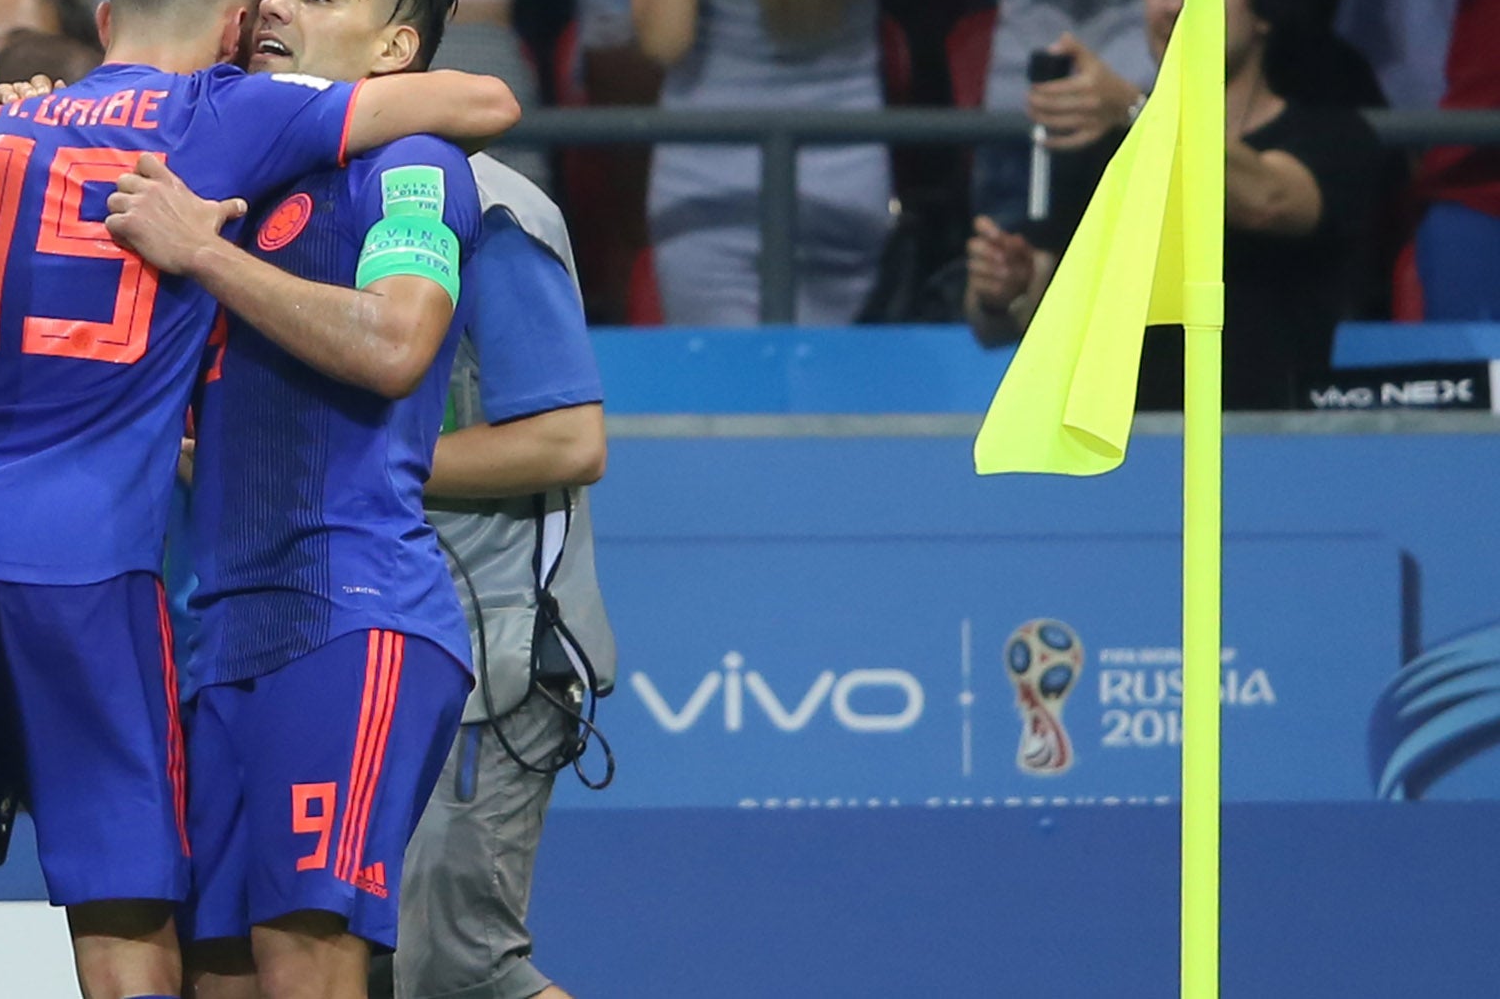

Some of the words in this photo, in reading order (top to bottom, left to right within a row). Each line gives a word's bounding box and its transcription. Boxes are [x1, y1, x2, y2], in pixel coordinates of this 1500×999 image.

[386, 183, 438, 193] LIVING
[363, 238, 449, 259] OOTBALL
[372, 228, 449, 249] IVING
[414, 253, 450, 277] FIFA
[1380, 378, 1473, 406] NEX
[630, 650, 926, 733] vivo
[1099, 668, 1278, 706] RUSIA
[1100, 708, 1183, 746] 201
[291, 781, 337, 872] 9
